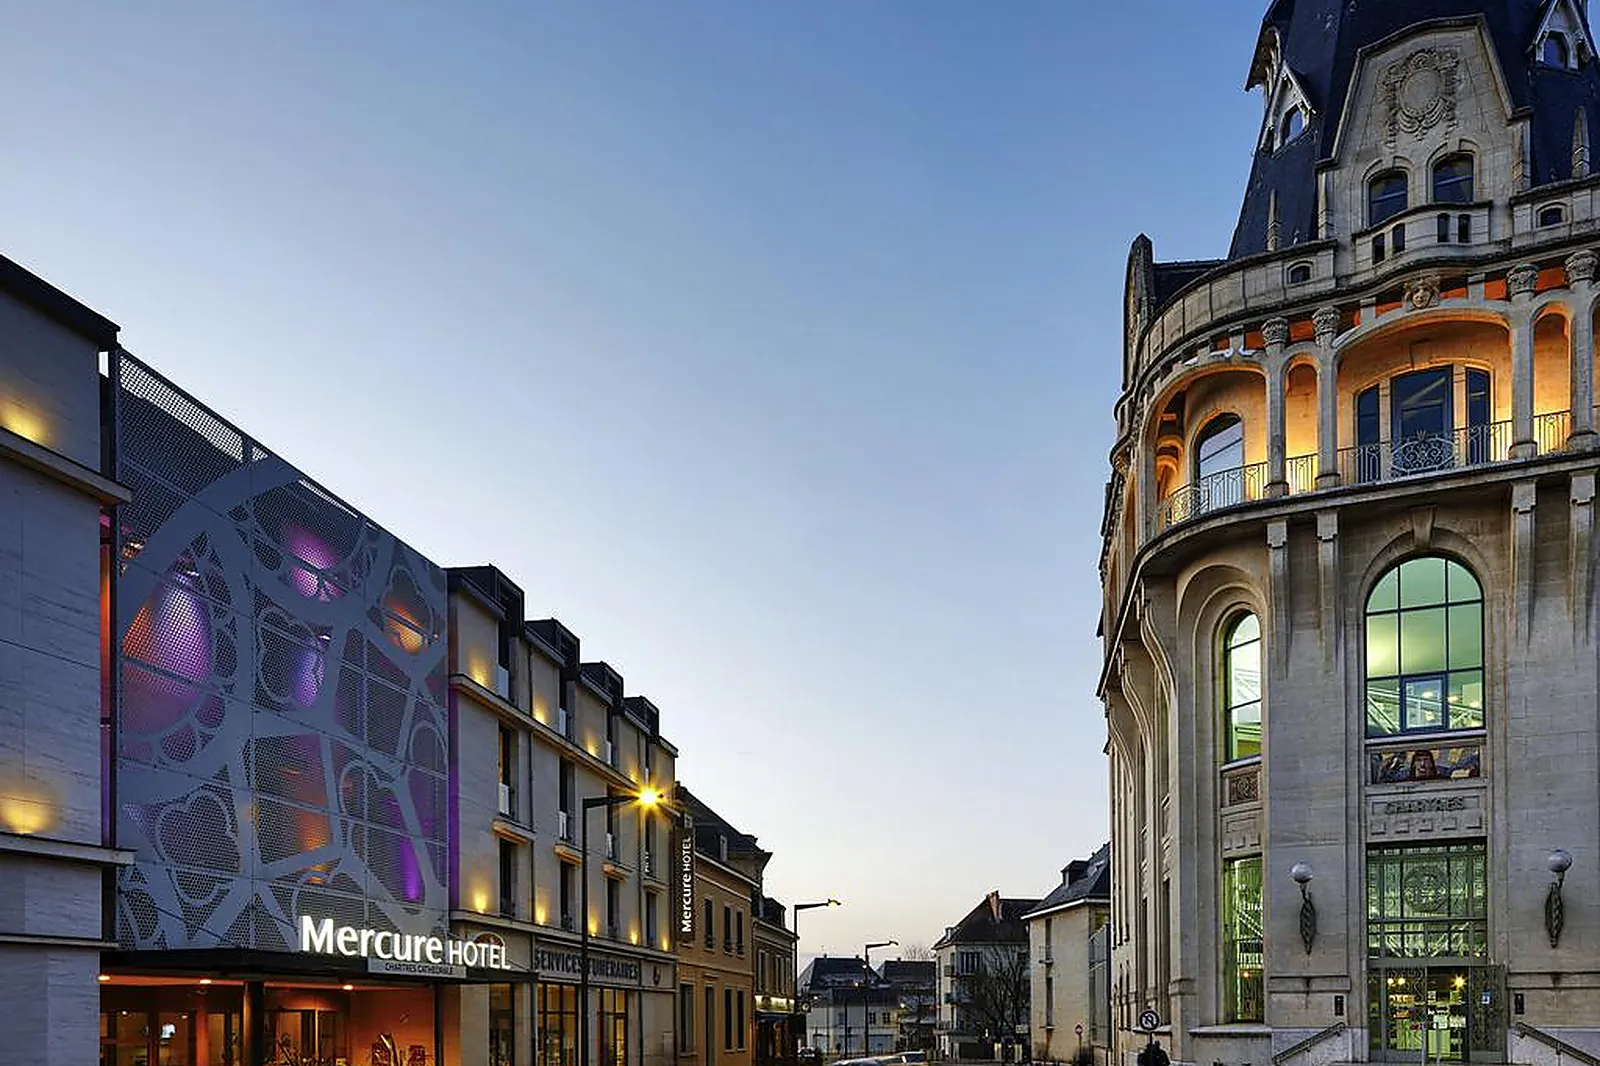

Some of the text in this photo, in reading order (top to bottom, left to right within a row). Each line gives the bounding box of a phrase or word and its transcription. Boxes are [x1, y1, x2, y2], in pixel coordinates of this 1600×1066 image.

[681, 837, 692, 933] Mercure HOTEL
[301, 915, 511, 970] Mercure HOTEL
[535, 950, 583, 973] SERVICES
